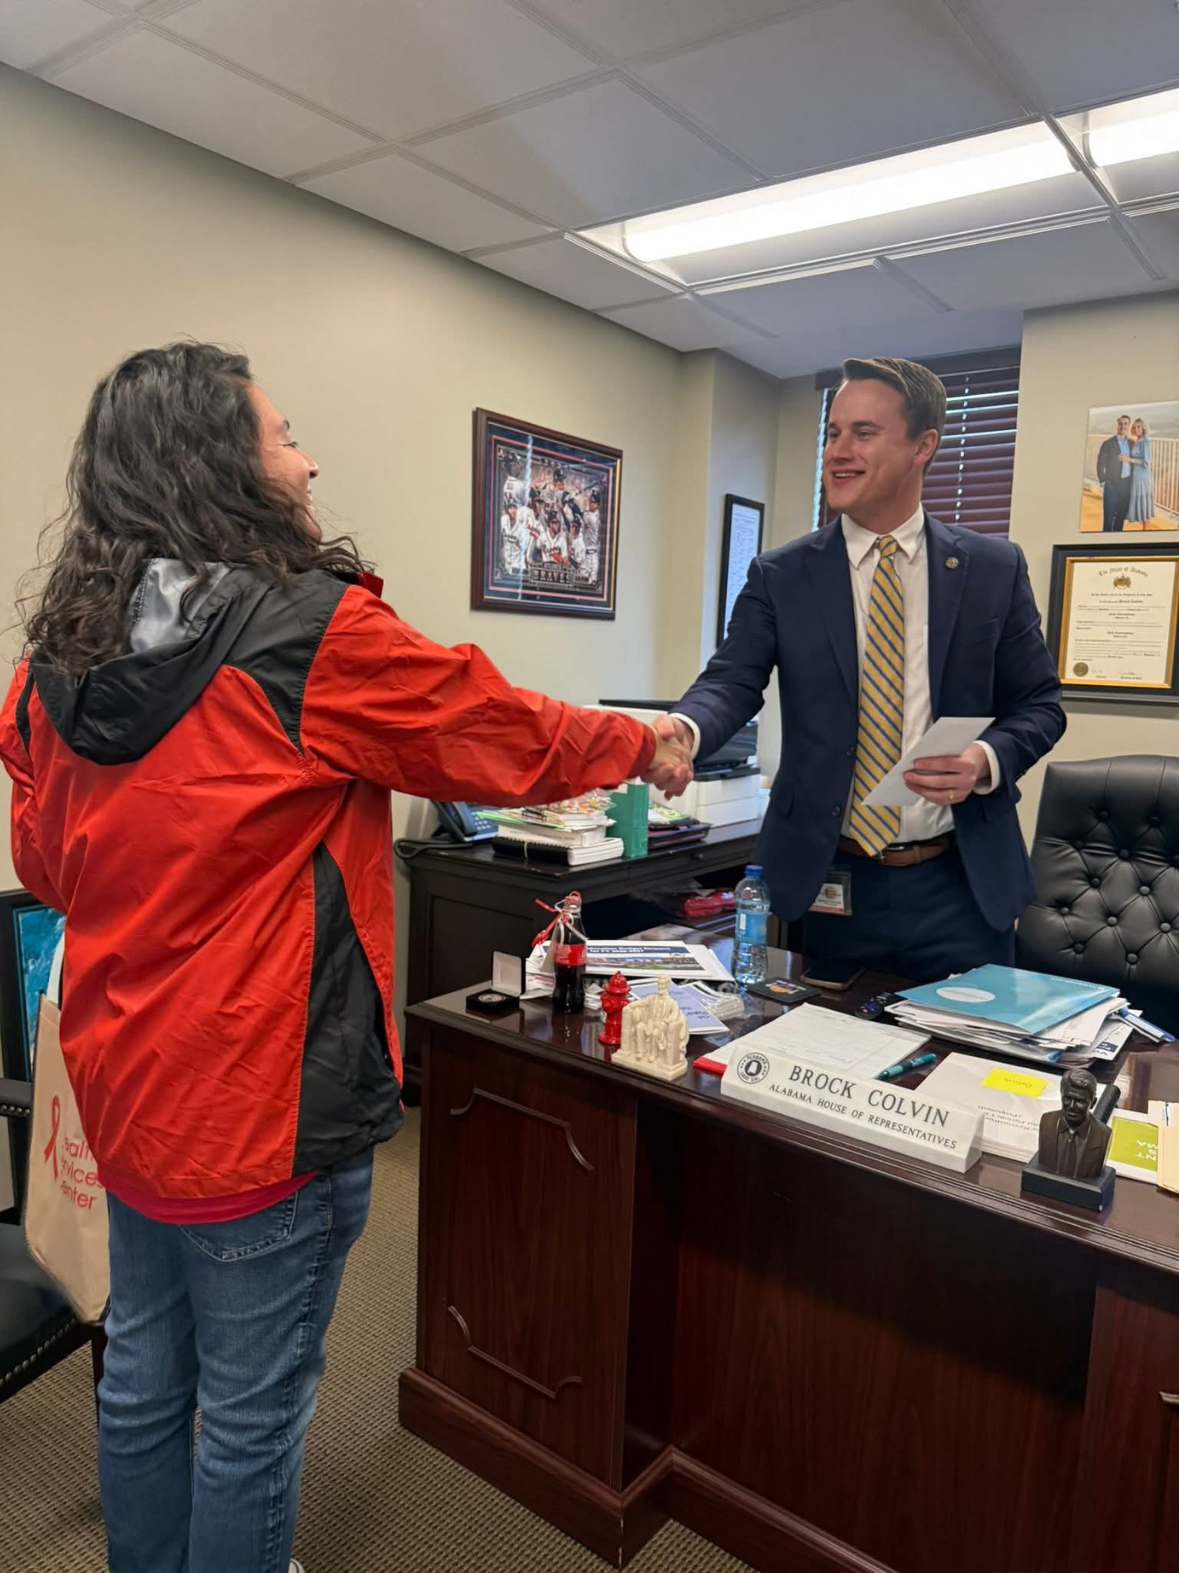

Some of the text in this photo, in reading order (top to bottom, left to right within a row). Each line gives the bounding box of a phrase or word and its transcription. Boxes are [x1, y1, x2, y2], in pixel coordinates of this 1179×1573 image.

[768, 1083, 958, 1149] ALABAMA HOUSE OF REPRESENTATIVES
[788, 1064, 857, 1099] BROCK
[867, 1089, 950, 1127] COLVIN
[60, 1180, 97, 1210] enter
